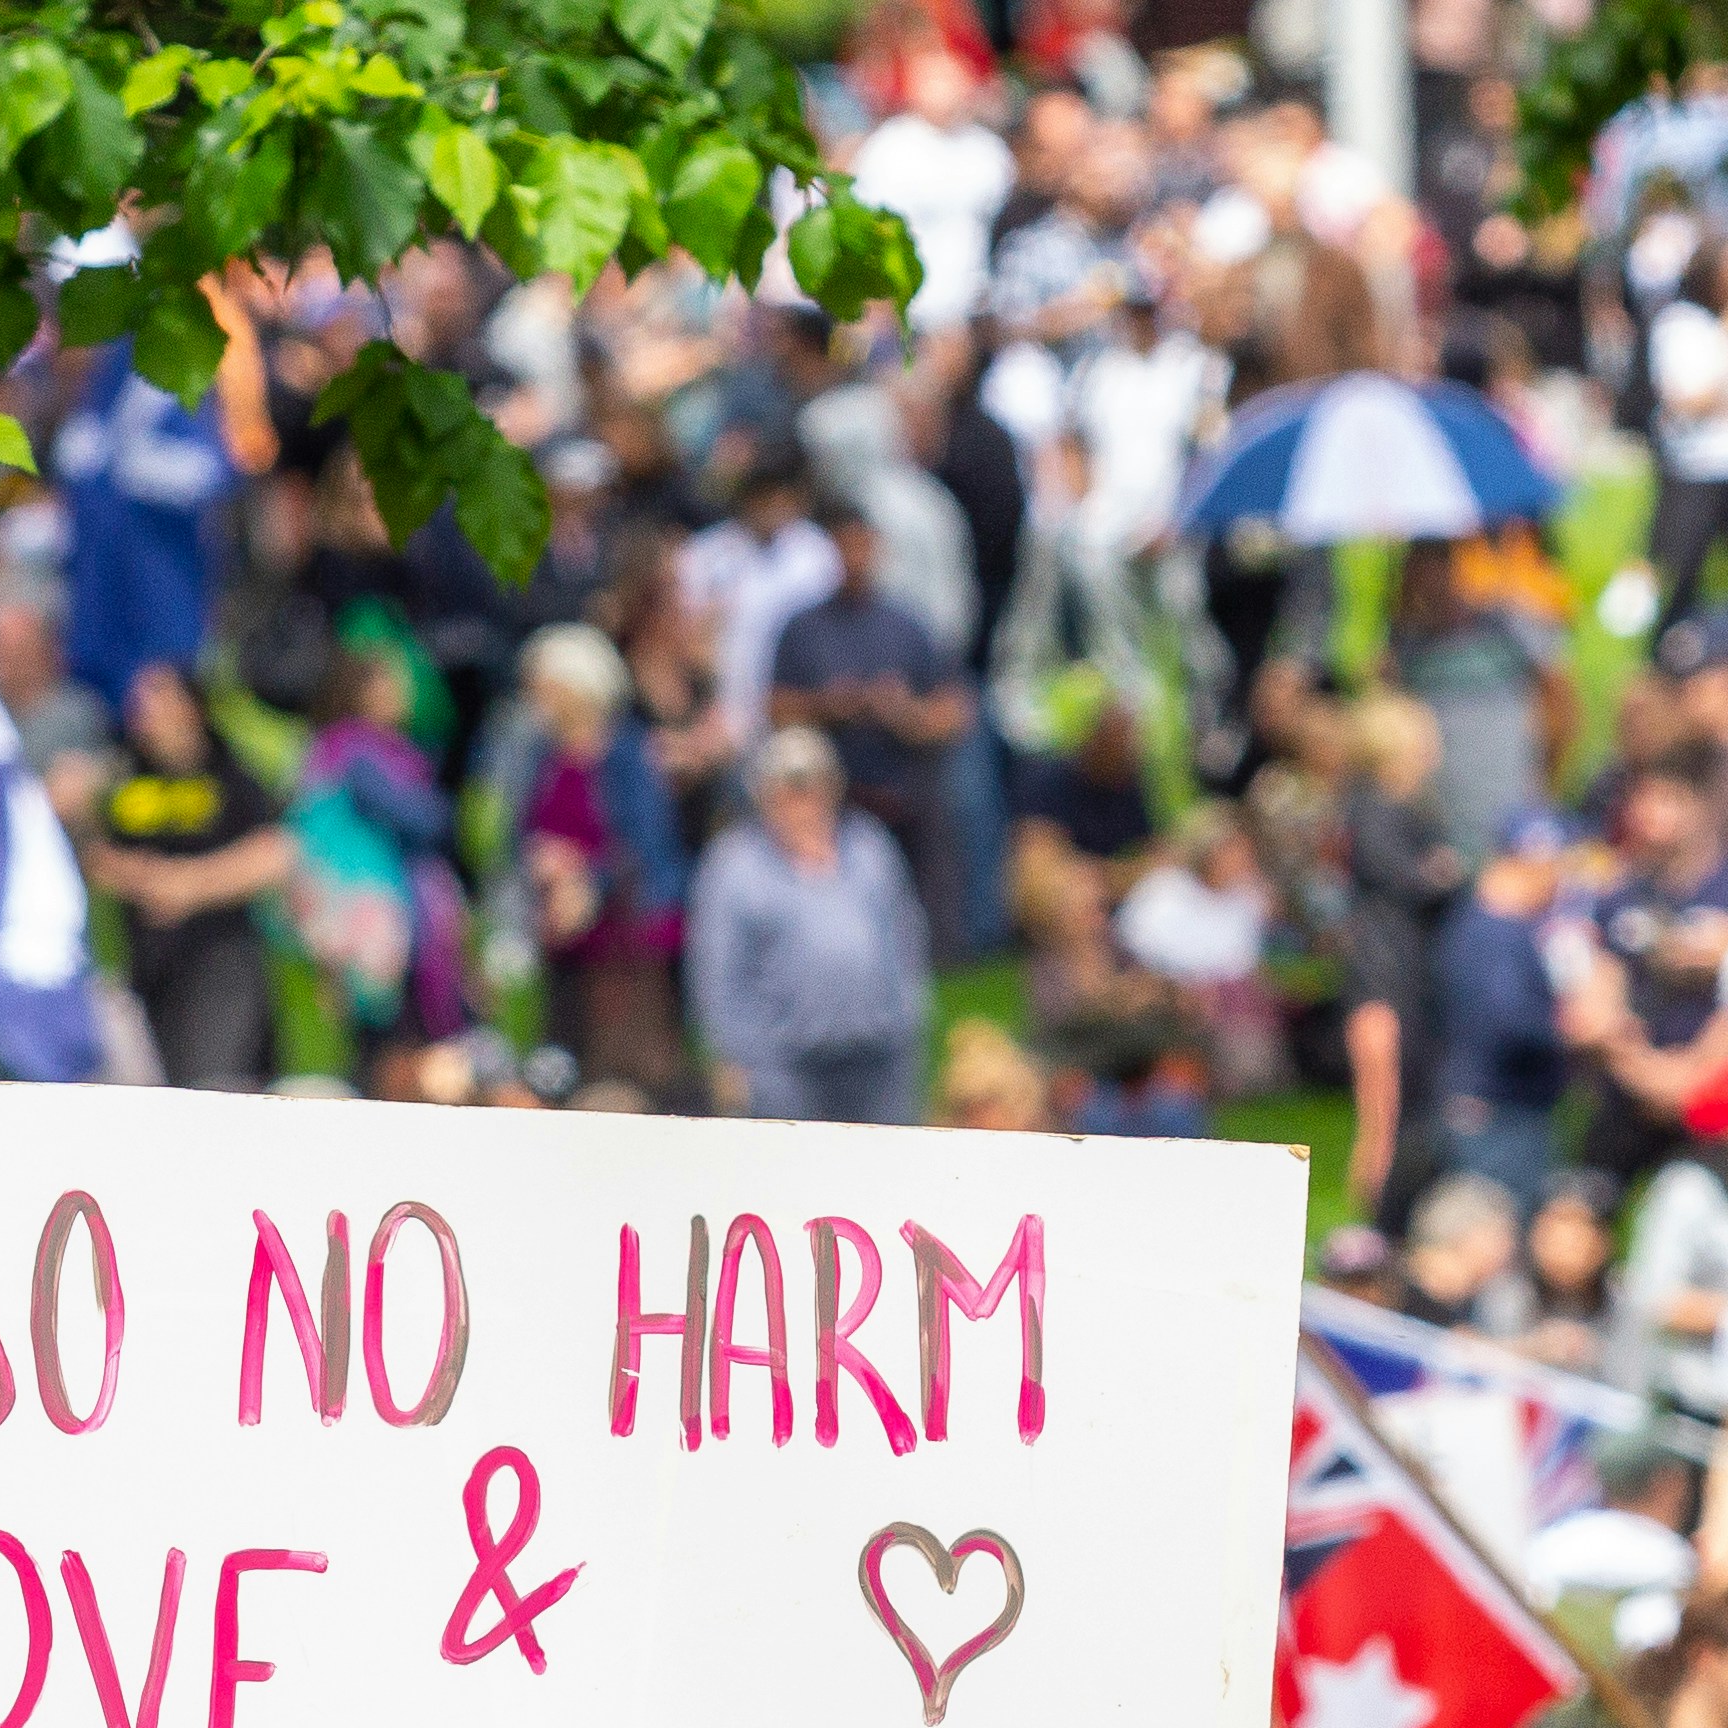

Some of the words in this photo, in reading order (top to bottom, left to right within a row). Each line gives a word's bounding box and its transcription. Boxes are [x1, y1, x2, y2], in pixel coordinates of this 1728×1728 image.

[238, 1199, 471, 1428] NO
[608, 1212, 1046, 1457] HARM
[440, 1445, 586, 1676] &
